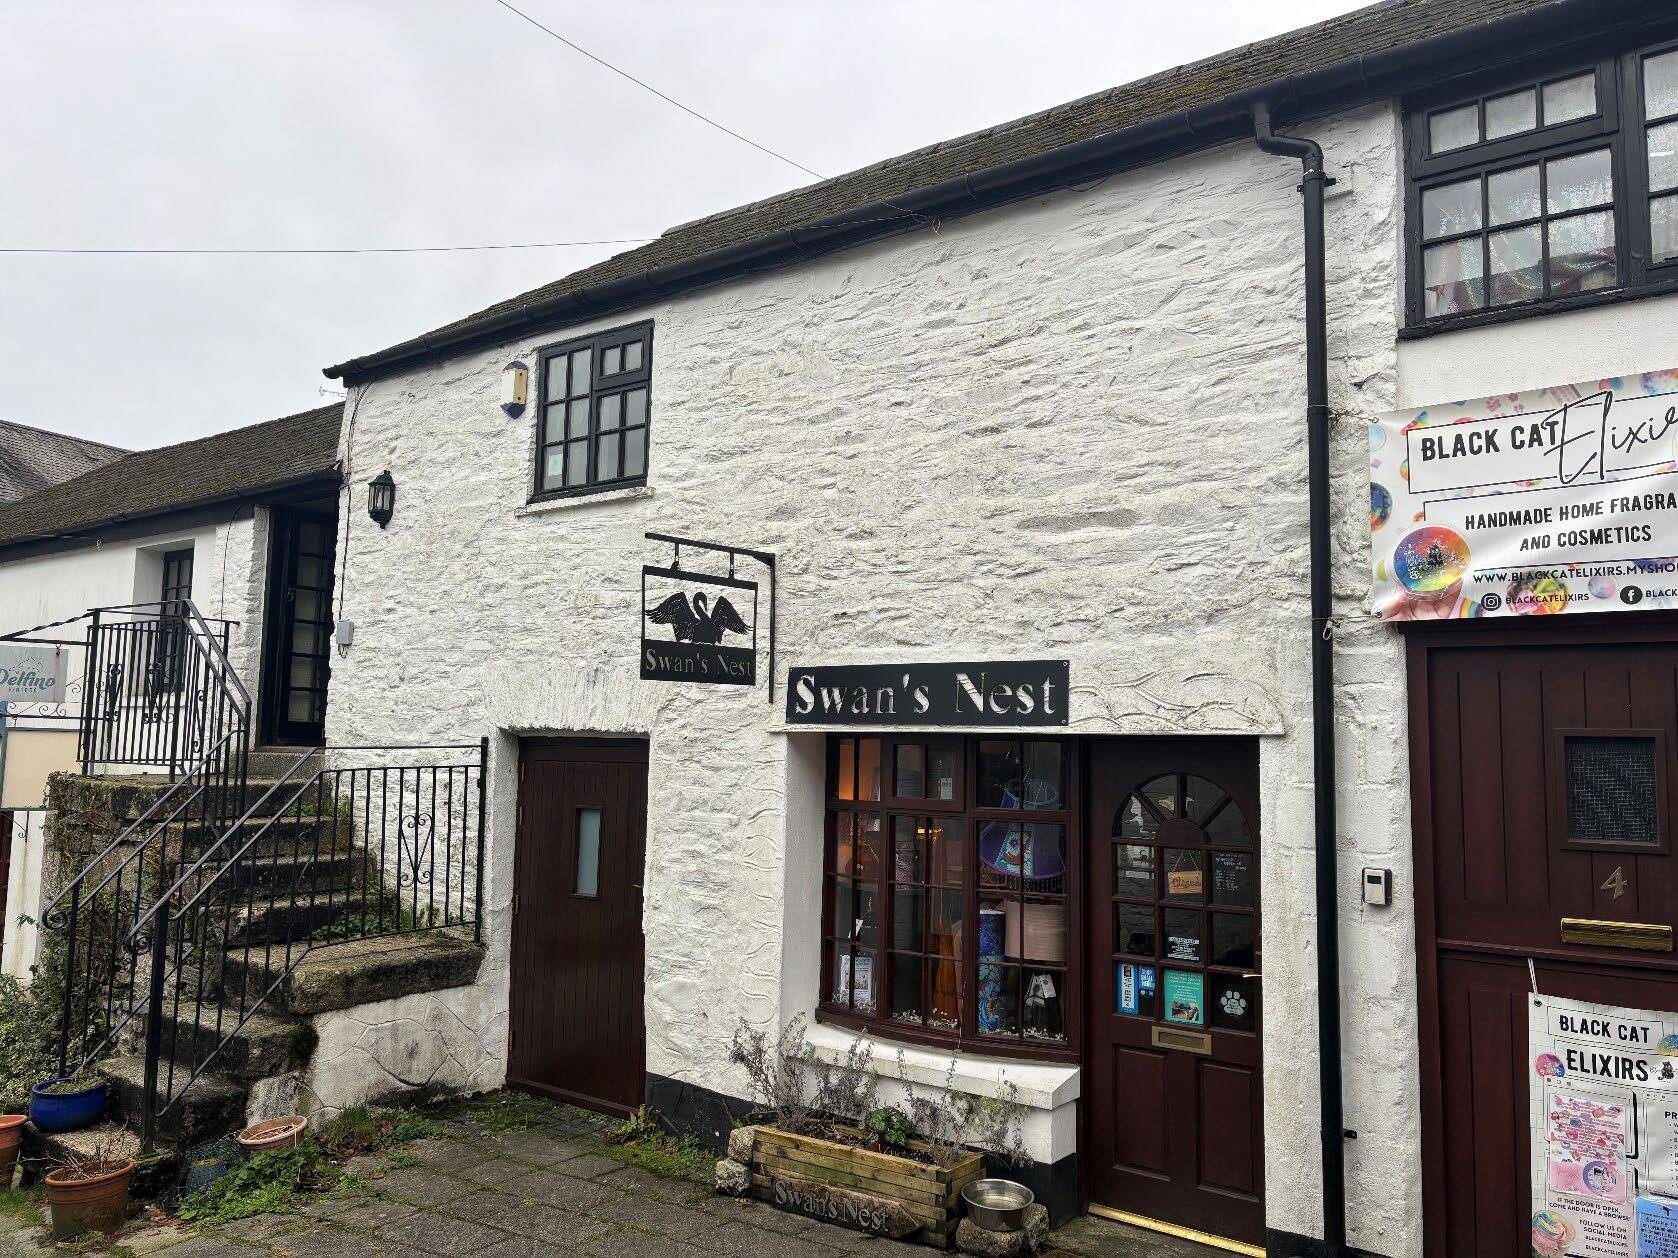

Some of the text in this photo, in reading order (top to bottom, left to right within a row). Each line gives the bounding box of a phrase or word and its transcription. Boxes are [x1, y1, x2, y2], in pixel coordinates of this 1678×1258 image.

[1421, 428, 1500, 462] BLACK
[1511, 421, 1560, 450] CAT
[1465, 492, 1678, 531] HANDMADE HOME FRAGRA
[1520, 524, 1652, 552] AND COSMETICS
[1506, 593, 1590, 605] BLACKCATELIXIRS
[644, 648, 753, 678] Swan's Nest
[795, 671, 1056, 715] Swan's Nest
[1600, 866, 1628, 899] 4
[1559, 1014, 1650, 1044] BLACK CAT
[1566, 1048, 1649, 1082] ELIXIRS
[775, 1180, 889, 1232] Swan's Nest
[1549, 1202, 1566, 1210] COME
[1579, 1220, 1605, 1228] FOLLOW
[1583, 1227, 1627, 1240] SOCIAL MEDIA
